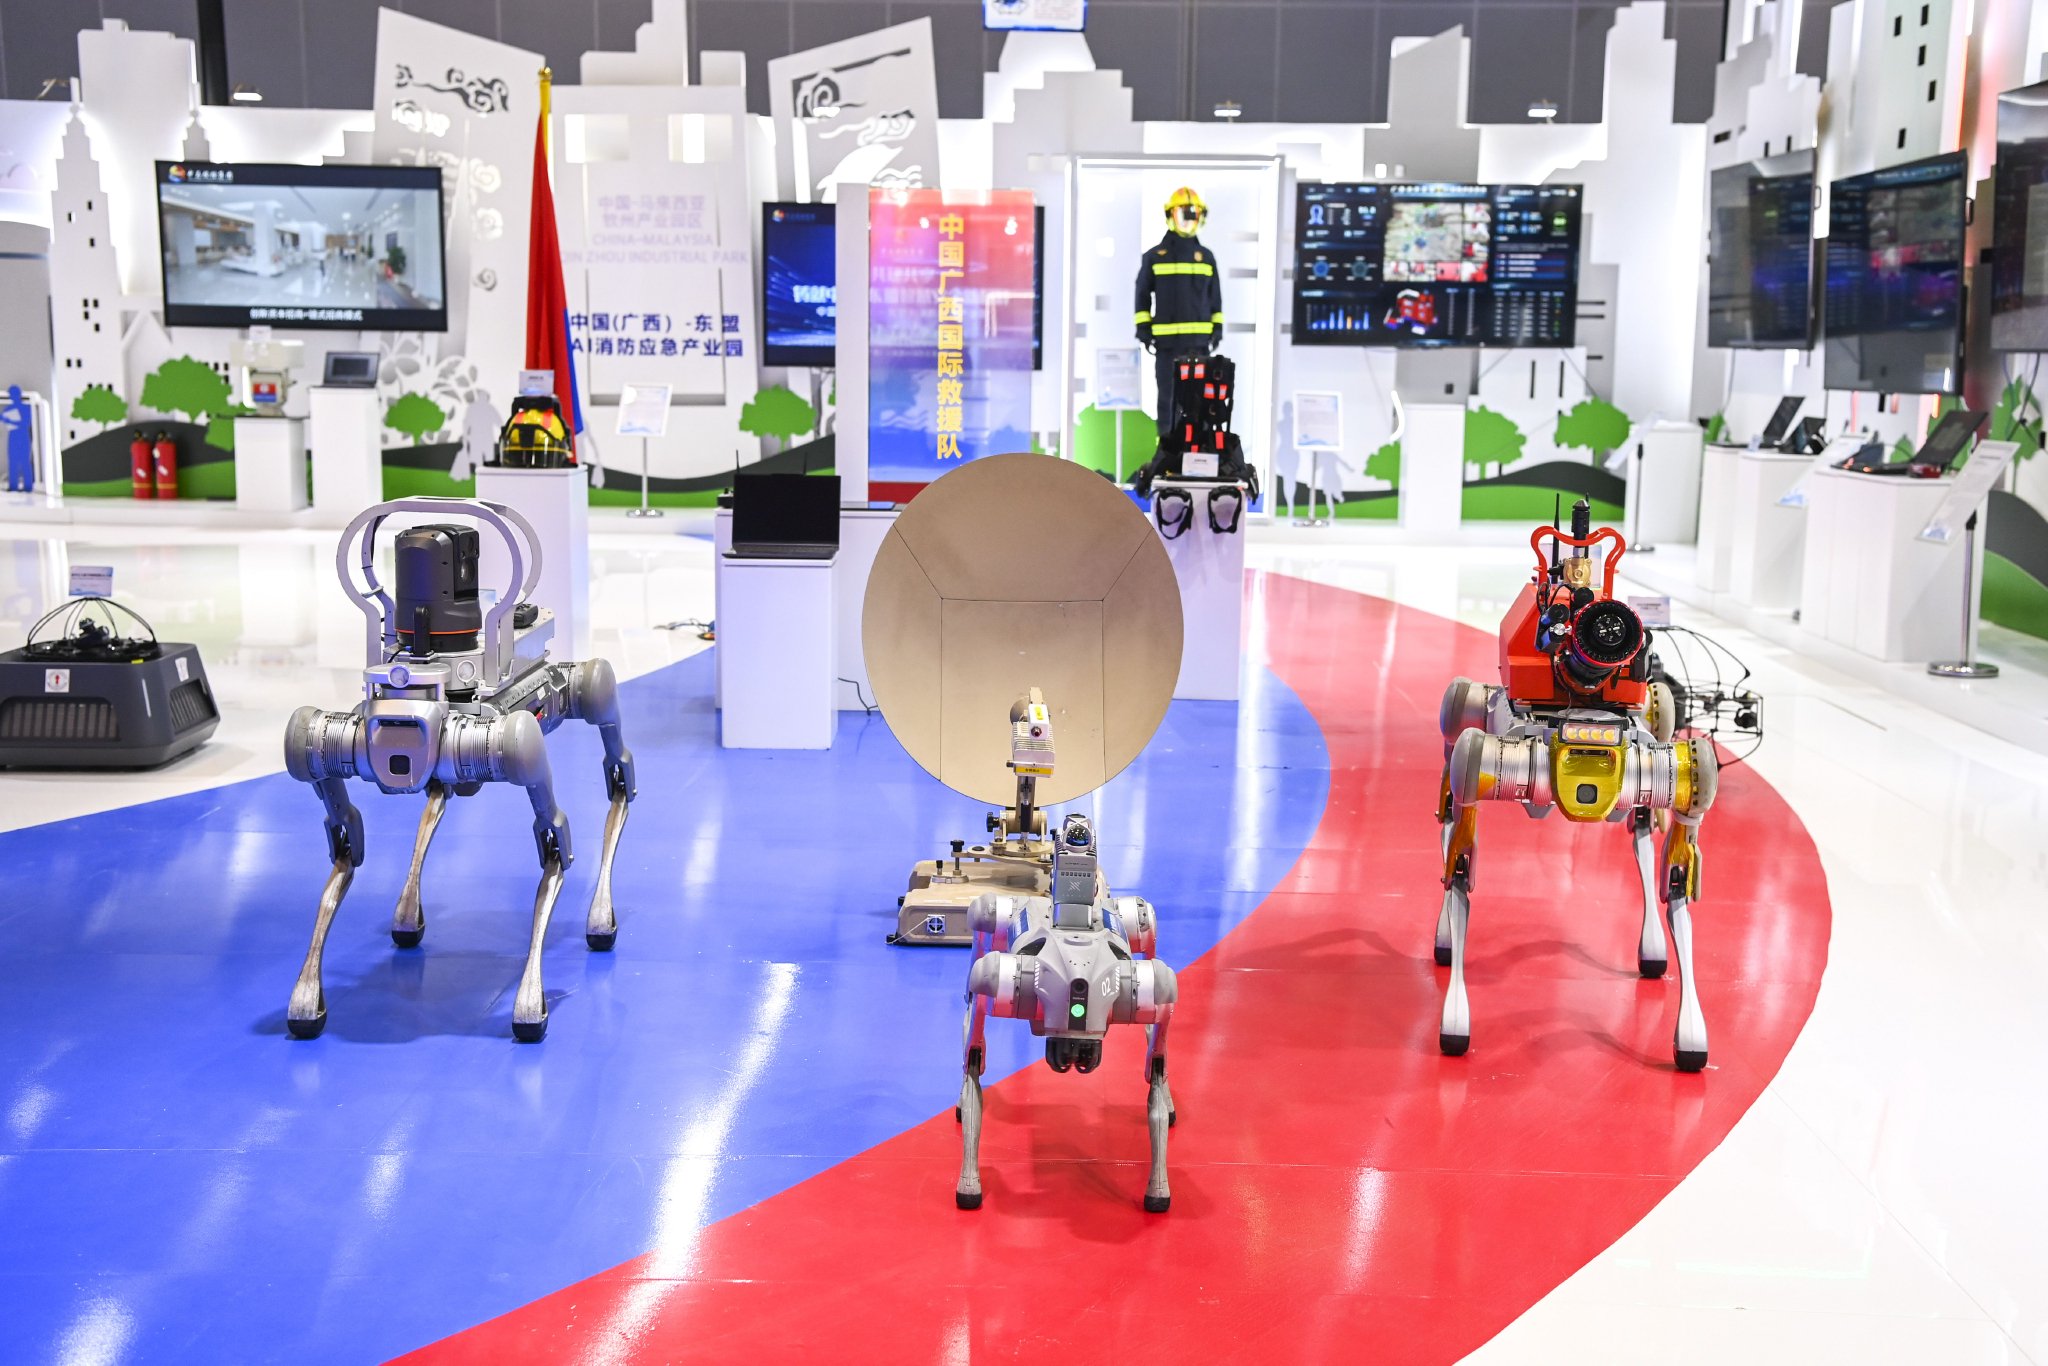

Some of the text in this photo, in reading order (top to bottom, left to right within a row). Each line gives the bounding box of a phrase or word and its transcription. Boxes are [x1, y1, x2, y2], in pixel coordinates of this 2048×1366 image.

[598, 195, 705, 211] 中国-马来西亚
[603, 213, 703, 229] 钦州产业园区
[592, 234, 713, 246] CHINA-MALAYSIA
[586, 251, 626, 263] ZHOU
[629, 251, 709, 263] INDUSTRIAL
[712, 251, 748, 263] PARK
[937, 213, 964, 460] 中国广西国际救援队
[571, 337, 743, 357] AI消防应急产业园
[1101, 977, 1113, 997] 02
